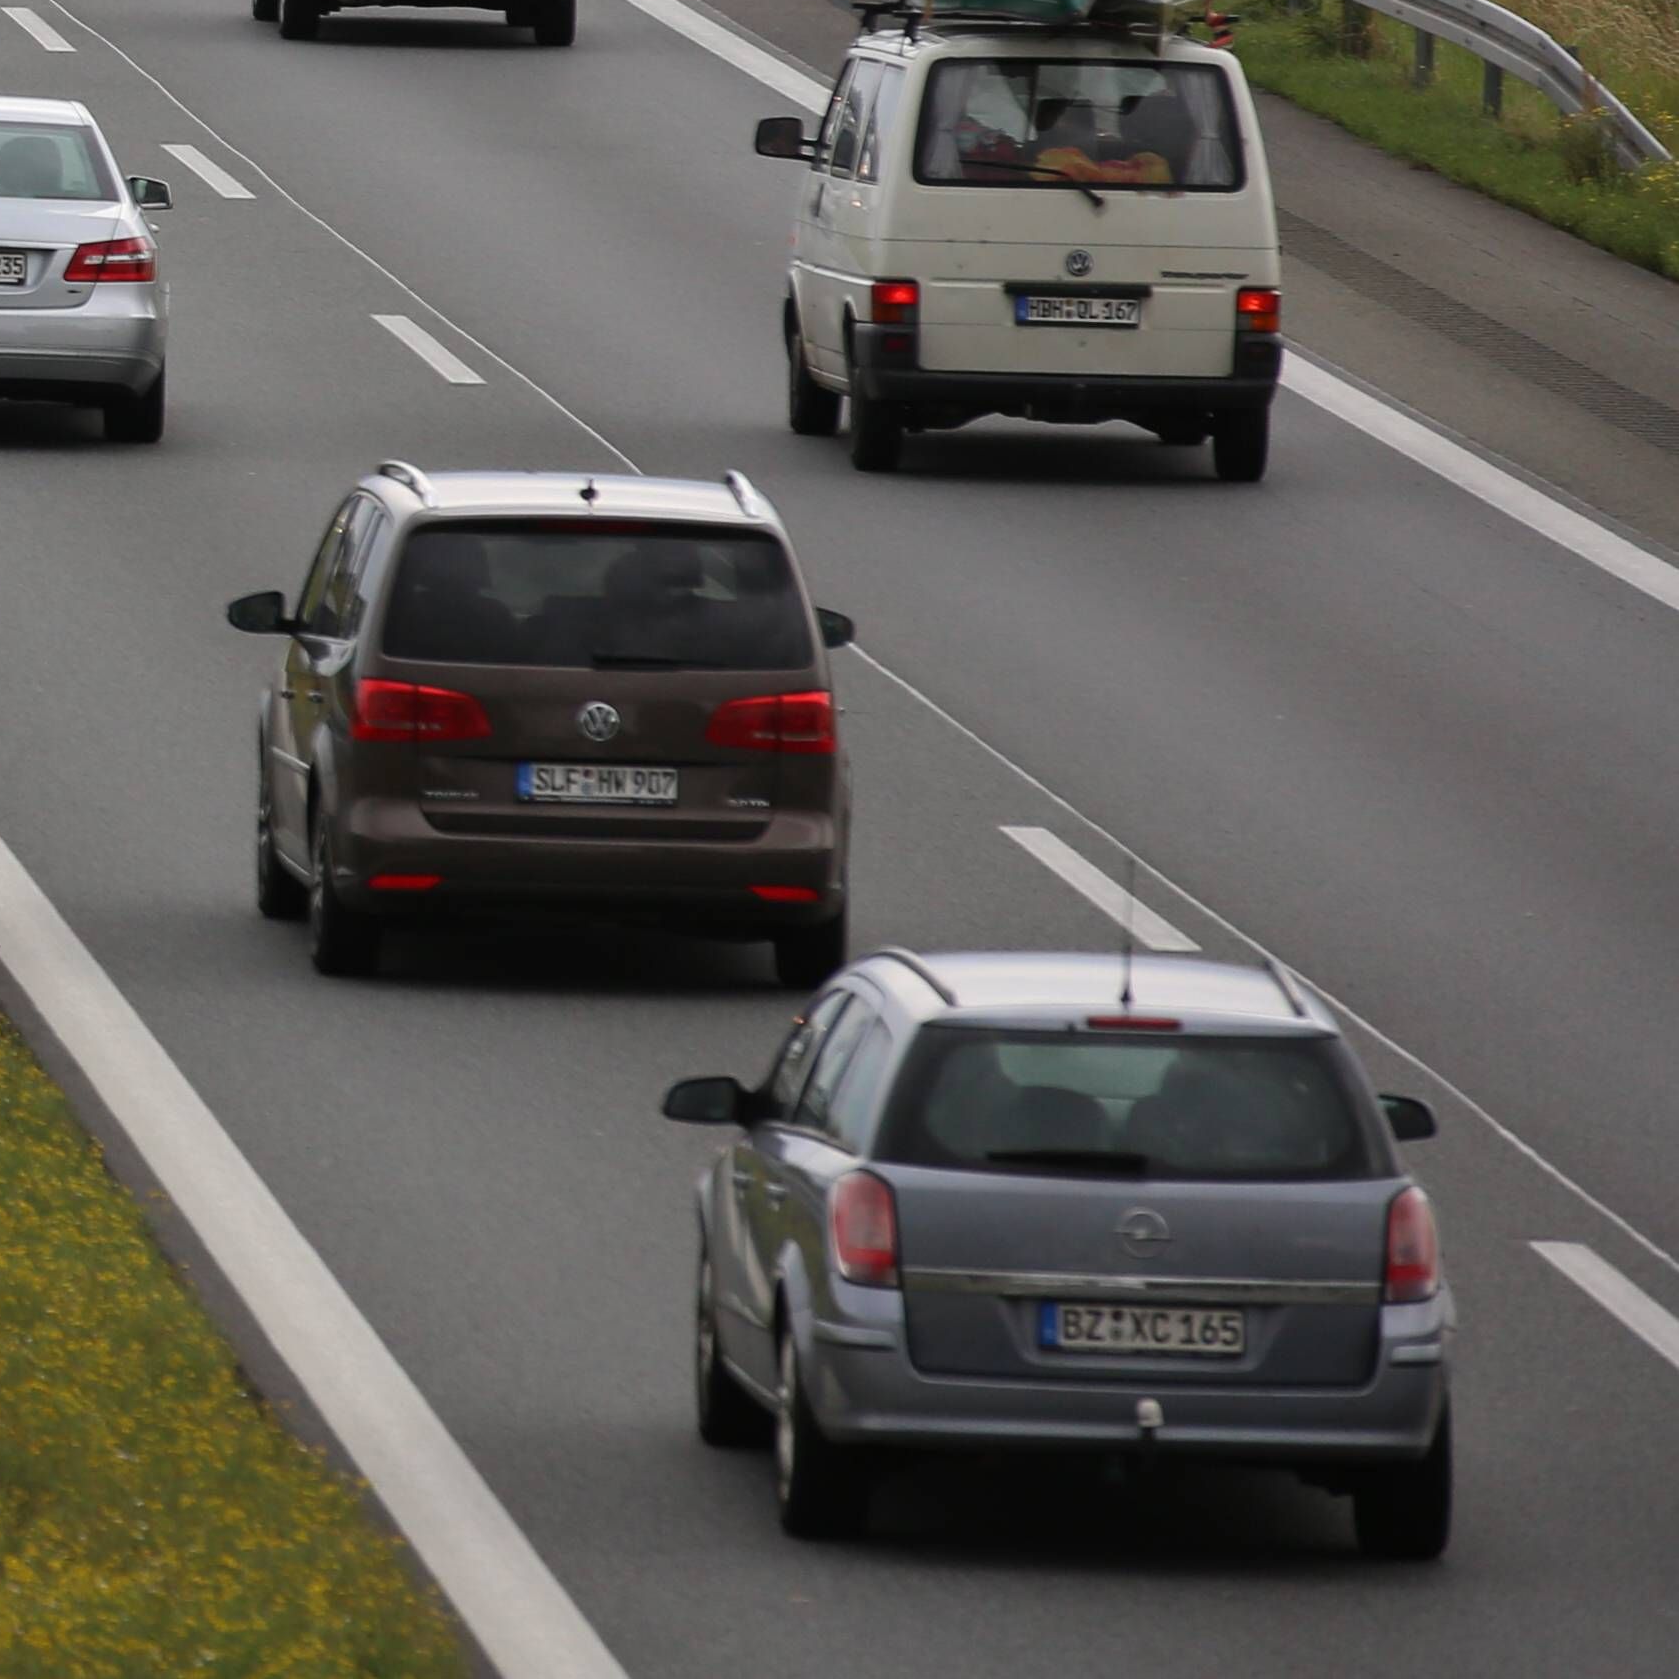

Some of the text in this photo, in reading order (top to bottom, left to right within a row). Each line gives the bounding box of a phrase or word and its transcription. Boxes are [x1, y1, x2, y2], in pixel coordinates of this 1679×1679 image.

[1104, 301, 1138, 321] 167
[536, 768, 581, 793] SLF
[634, 771, 676, 796] 907
[1063, 1310, 1242, 1345] BZ XC 165
